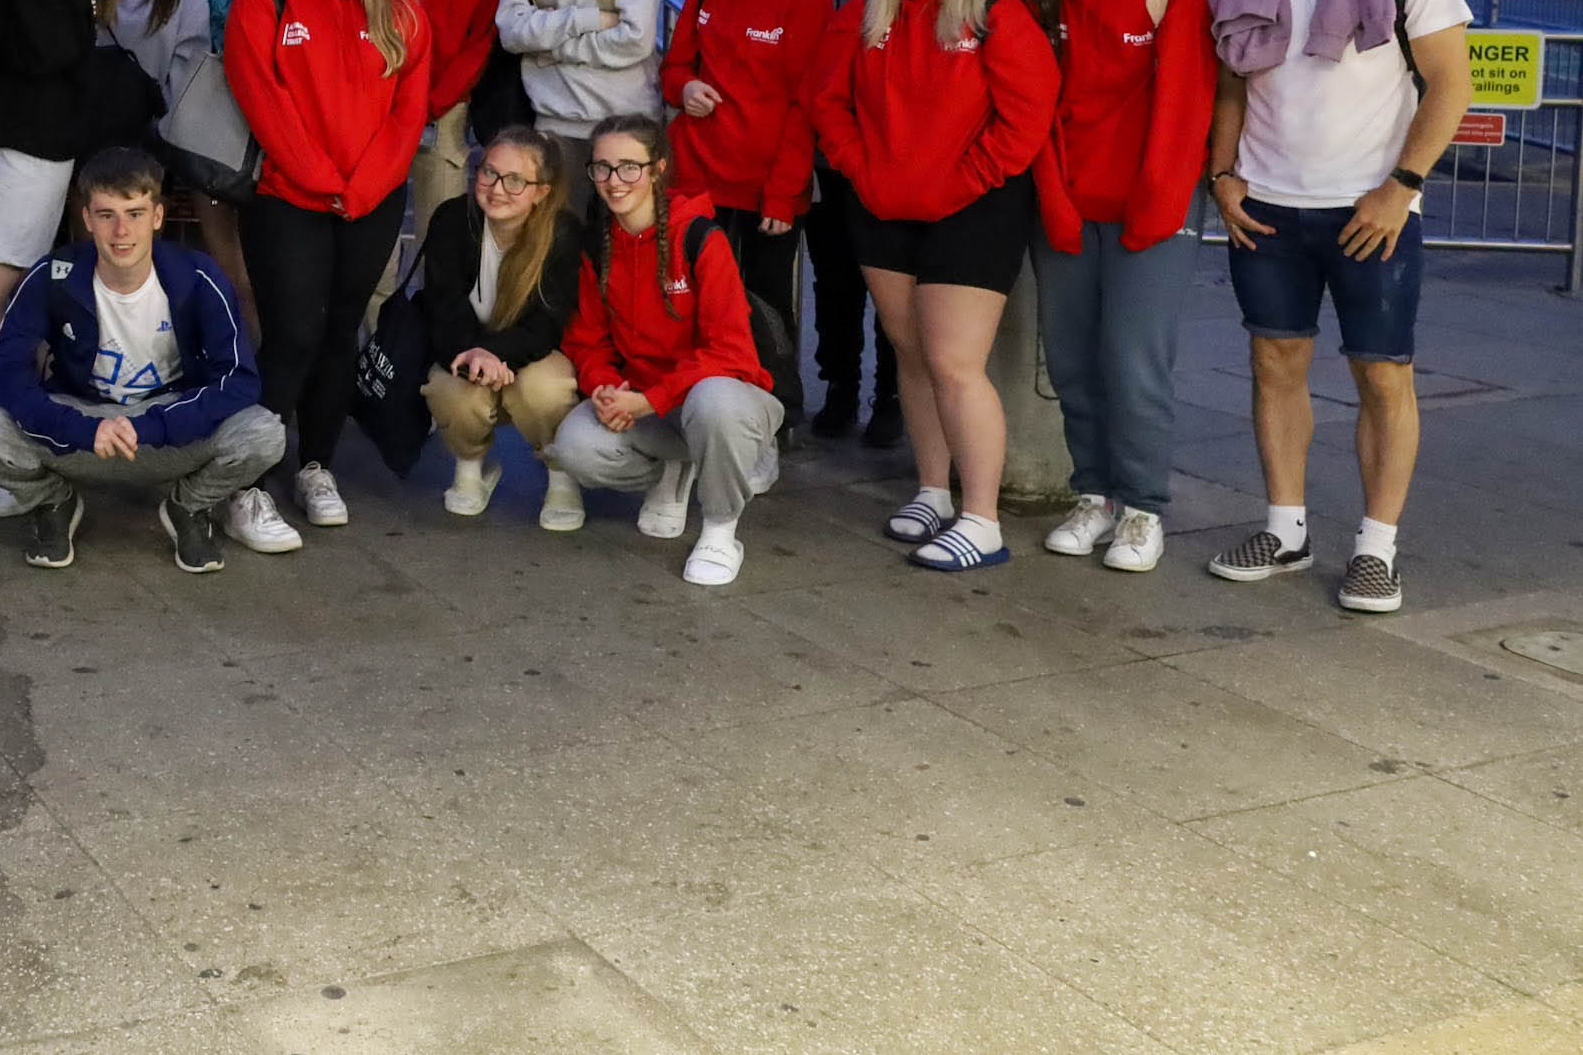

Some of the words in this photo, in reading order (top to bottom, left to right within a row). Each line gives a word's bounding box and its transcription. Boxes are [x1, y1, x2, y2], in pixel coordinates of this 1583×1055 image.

[746, 27, 781, 41] Franklin
[1468, 45, 1529, 62] NGER
[1470, 67, 1485, 79] ot
[1489, 68, 1505, 79] sit
[1509, 70, 1527, 79] on
[1473, 80, 1520, 95] ailings
